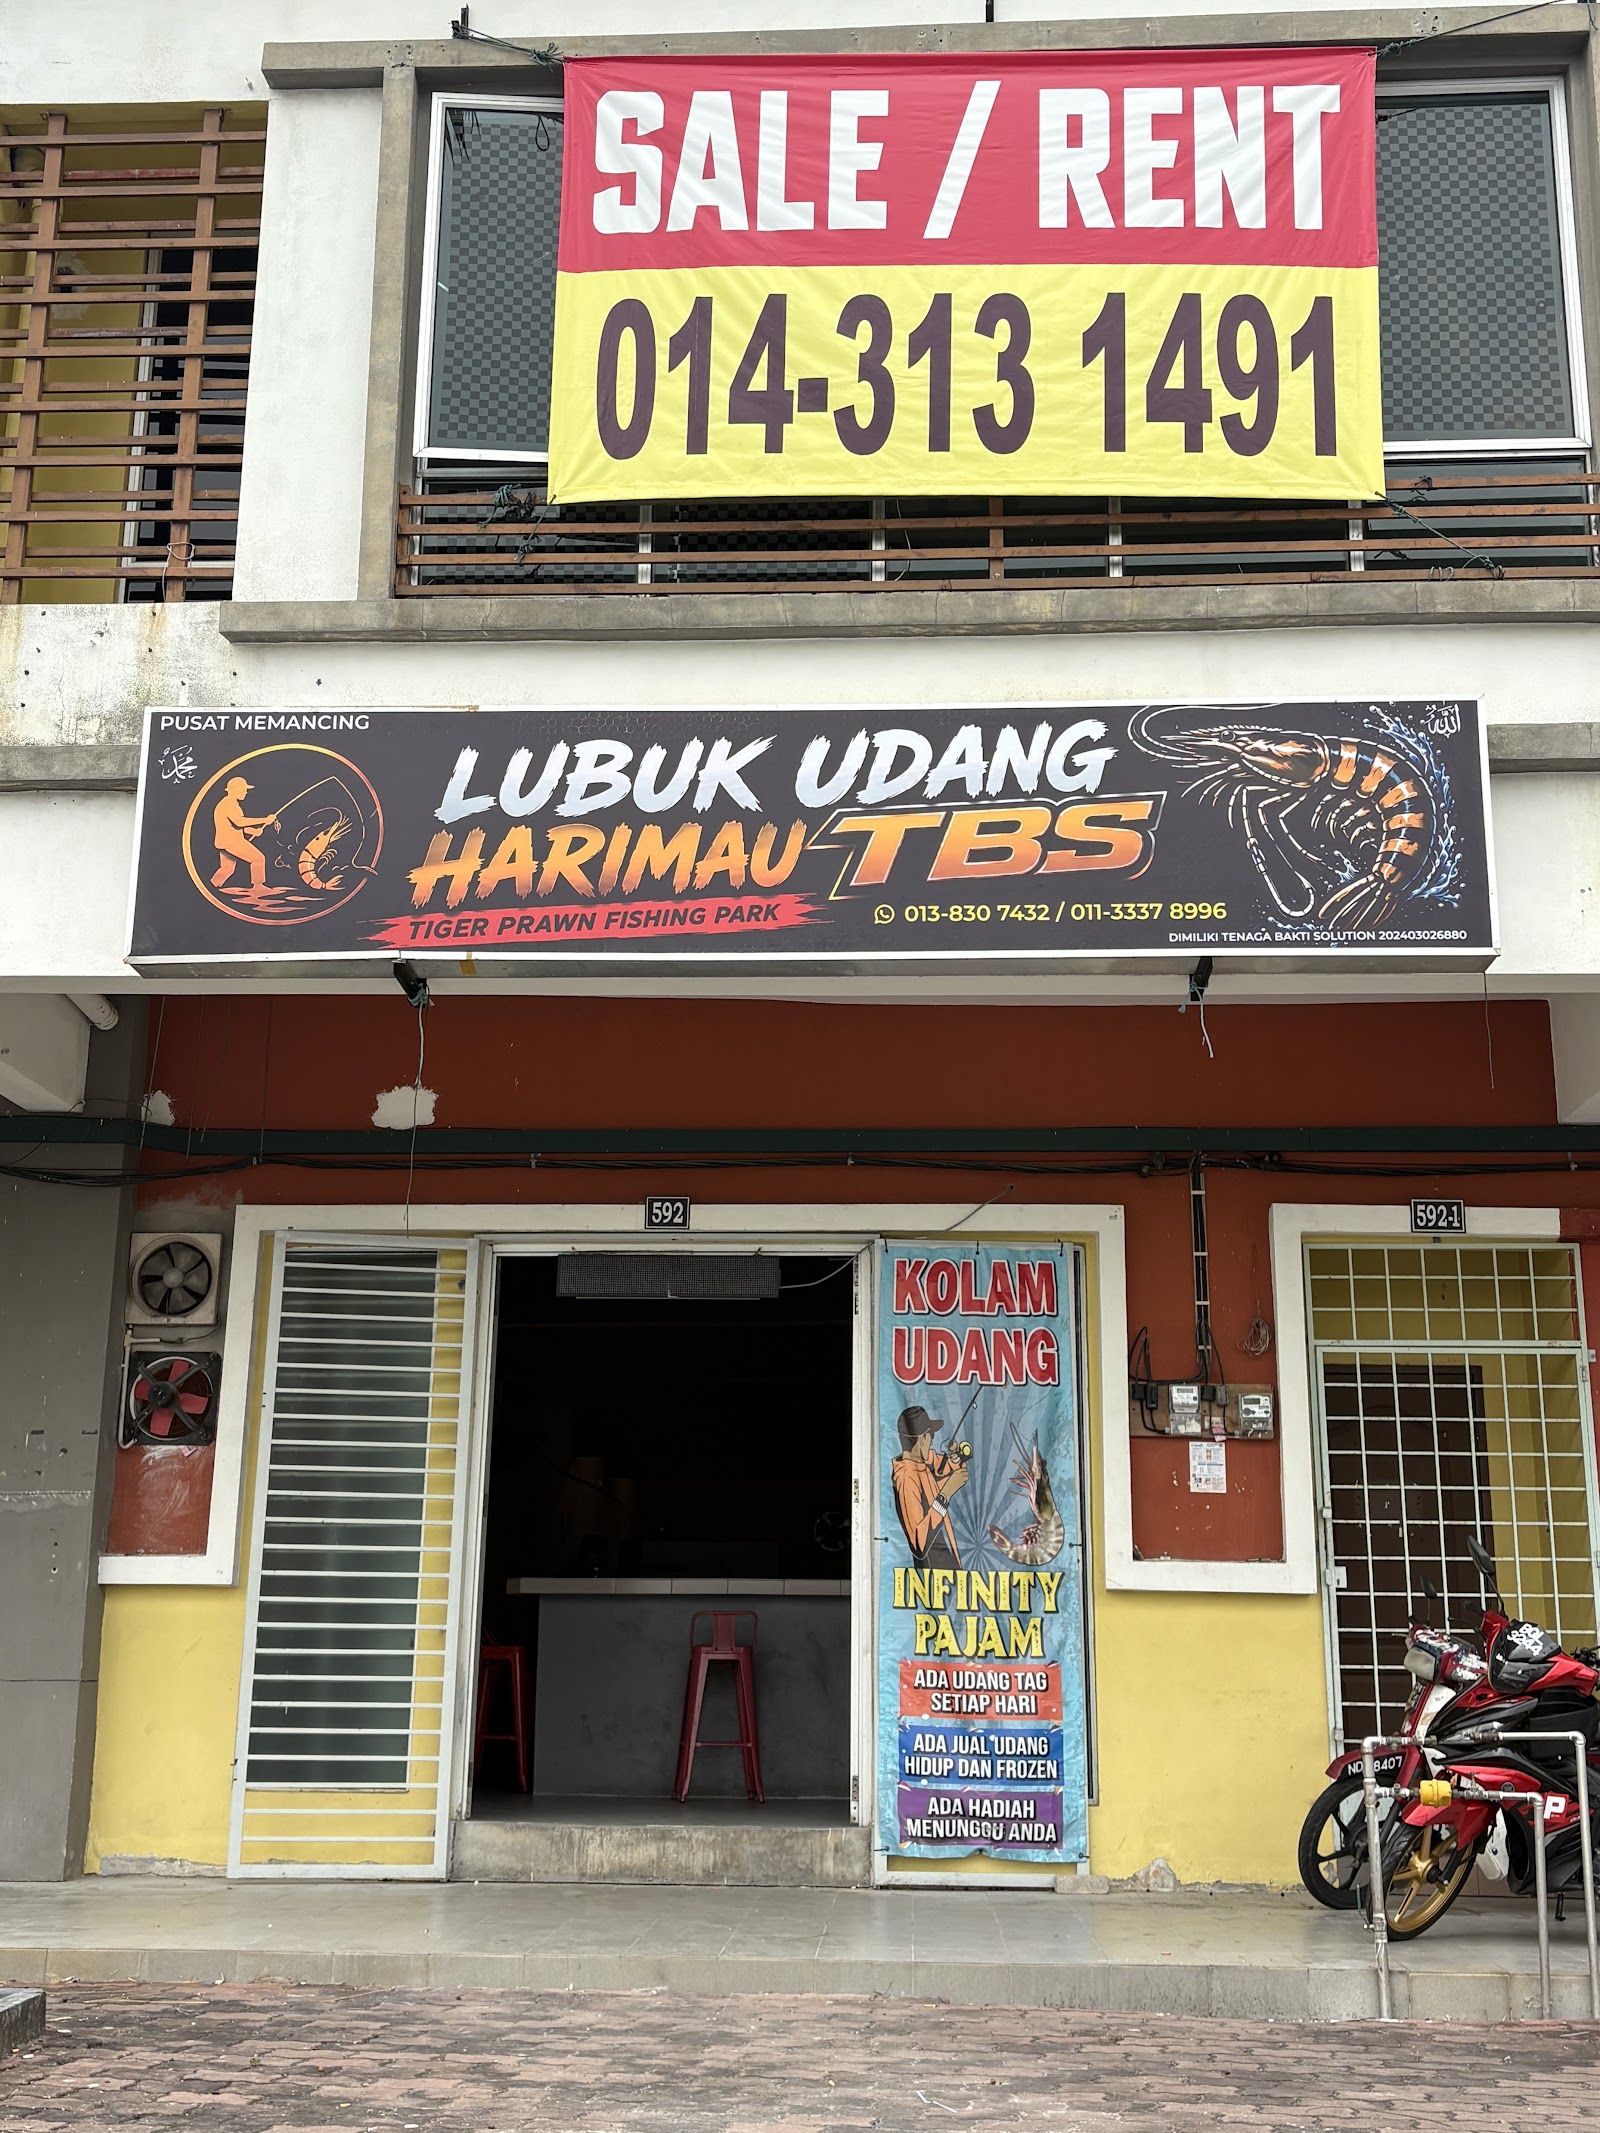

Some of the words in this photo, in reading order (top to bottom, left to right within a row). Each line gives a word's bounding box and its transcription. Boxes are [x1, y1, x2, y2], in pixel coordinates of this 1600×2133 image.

[592, 89, 890, 235] SALE
[923, 80, 1001, 239] /
[1038, 85, 1342, 231] RENT
[596, 292, 1036, 460] 014-313
[1081, 292, 1338, 457] 1491
[160, 715, 230, 731] PUSAT
[235, 714, 370, 731] MEMANCING
[433, 735, 778, 823] LUBUK
[796, 718, 1119, 808] UDANG
[407, 819, 806, 908] HARIMAU
[832, 800, 1155, 886] TBS
[408, 917, 489, 941] TIGER
[497, 911, 597, 936] PRAWN
[603, 906, 706, 931] FISHING
[713, 902, 783, 925] PARK
[904, 904, 991, 923] 013-830
[996, 903, 1050, 923] 7432
[1055, 900, 1066, 924] /
[1070, 902, 1163, 922] 011-3337
[1168, 901, 1228, 921] 8996
[1168, 932, 1220, 943] DIMILIKI
[1221, 932, 1272, 942] TENAGA
[1274, 931, 1311, 942] BAKTI
[1313, 931, 1376, 941] SOLUTION
[1378, 930, 1468, 941] 202403026880
[651, 1202, 684, 1224] 592
[1416, 1204, 1460, 1228] 592-1
[893, 1258, 1058, 1315] KOLAM
[891, 1325, 1060, 1387] UDANG
[892, 1567, 1064, 1613] INFINITY
[914, 1613, 1045, 1658] PAJAM
[914, 1668, 949, 1690] ADA
[952, 1669, 1010, 1691] UDANG
[1014, 1671, 1047, 1692] TAG
[930, 1692, 991, 1714] SETIAP
[995, 1694, 1037, 1715] HARI
[913, 1732, 947, 1754] ADA
[950, 1734, 989, 1755] JUAL
[994, 1736, 1048, 1756] UDANG
[904, 1755, 954, 1777] HIDUP
[958, 1758, 992, 1778] DAN
[996, 1759, 1058, 1780] FROZEN
[1373, 1755, 1403, 1772] 8407
[927, 1796, 966, 1817] ADA
[968, 1798, 1035, 1819] HADIAH
[1543, 1795, 1567, 1820] P
[906, 1818, 1005, 1841] MENUNGGU
[1008, 1821, 1058, 1843] ANDA
